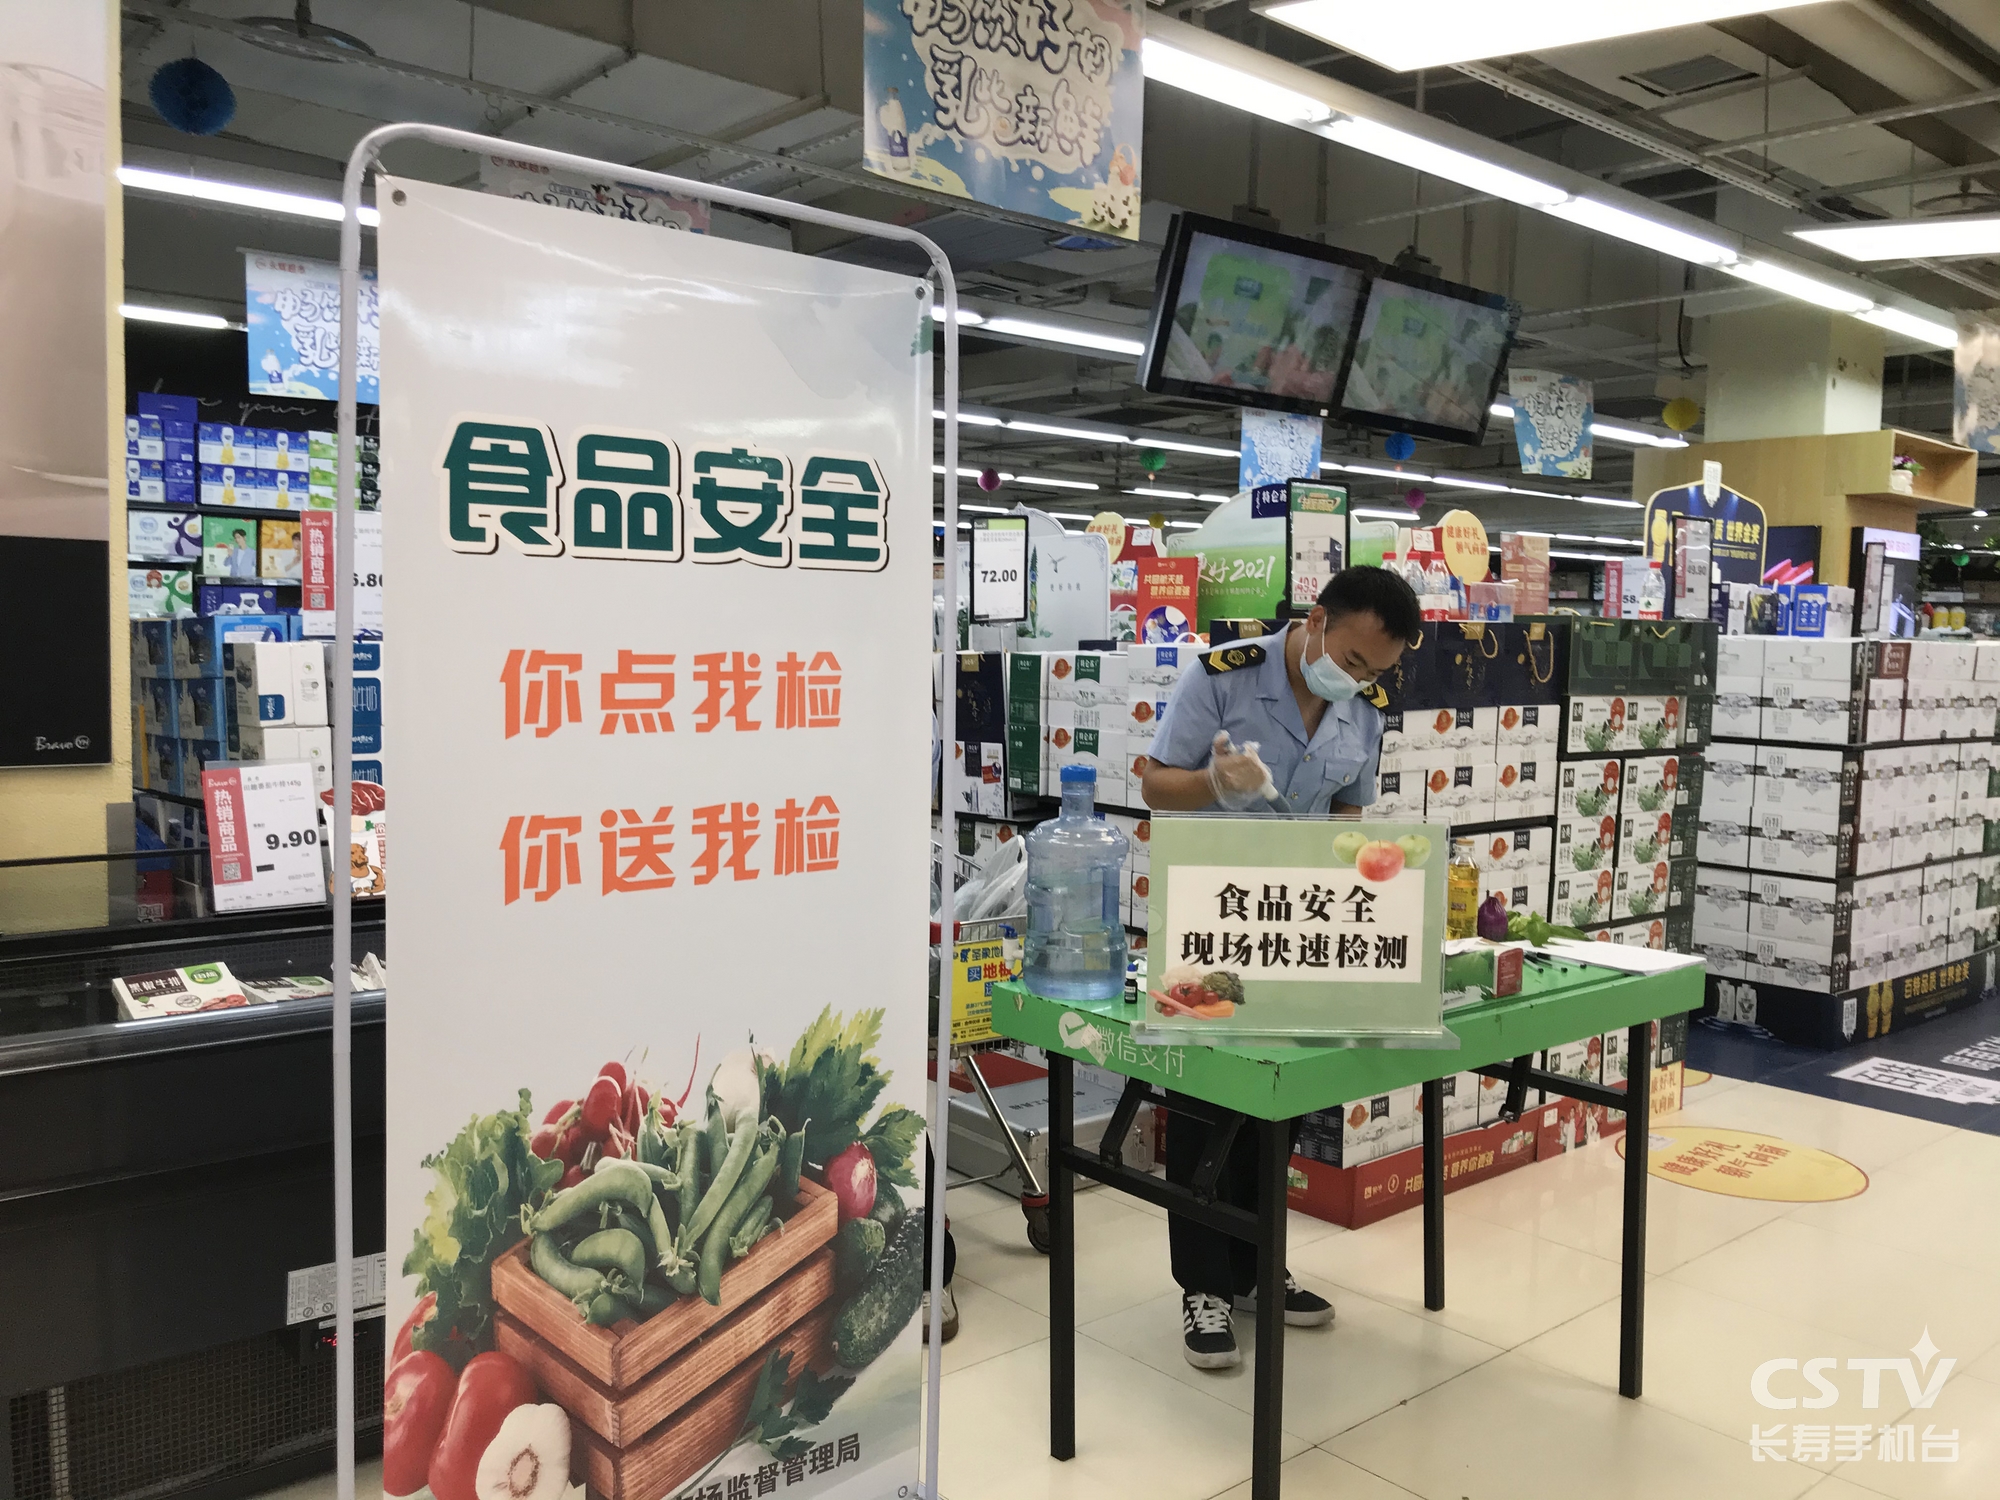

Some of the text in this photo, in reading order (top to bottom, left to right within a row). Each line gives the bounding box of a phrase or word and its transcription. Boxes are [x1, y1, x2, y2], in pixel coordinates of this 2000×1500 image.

[440, 414, 889, 571] 食品安全
[1446, 525, 1480, 541] 健康好礼
[980, 569, 1018, 583] 72.00
[500, 649, 842, 740] 你点我检
[214, 788, 238, 853] 热销商品
[266, 829, 317, 850] 9.90
[499, 795, 840, 906] 你送我检
[1214, 882, 1378, 923] 食品安全
[972, 946, 1003, 961] 圣象地
[1180, 931, 1409, 970] 现场快速检测
[128, 976, 181, 994] 黑椒牛排
[1093, 1024, 1186, 1078] 微信支付
[1659, 1139, 1741, 1176] 健康好礼
[1714, 1143, 1791, 1179] 朝气向前
